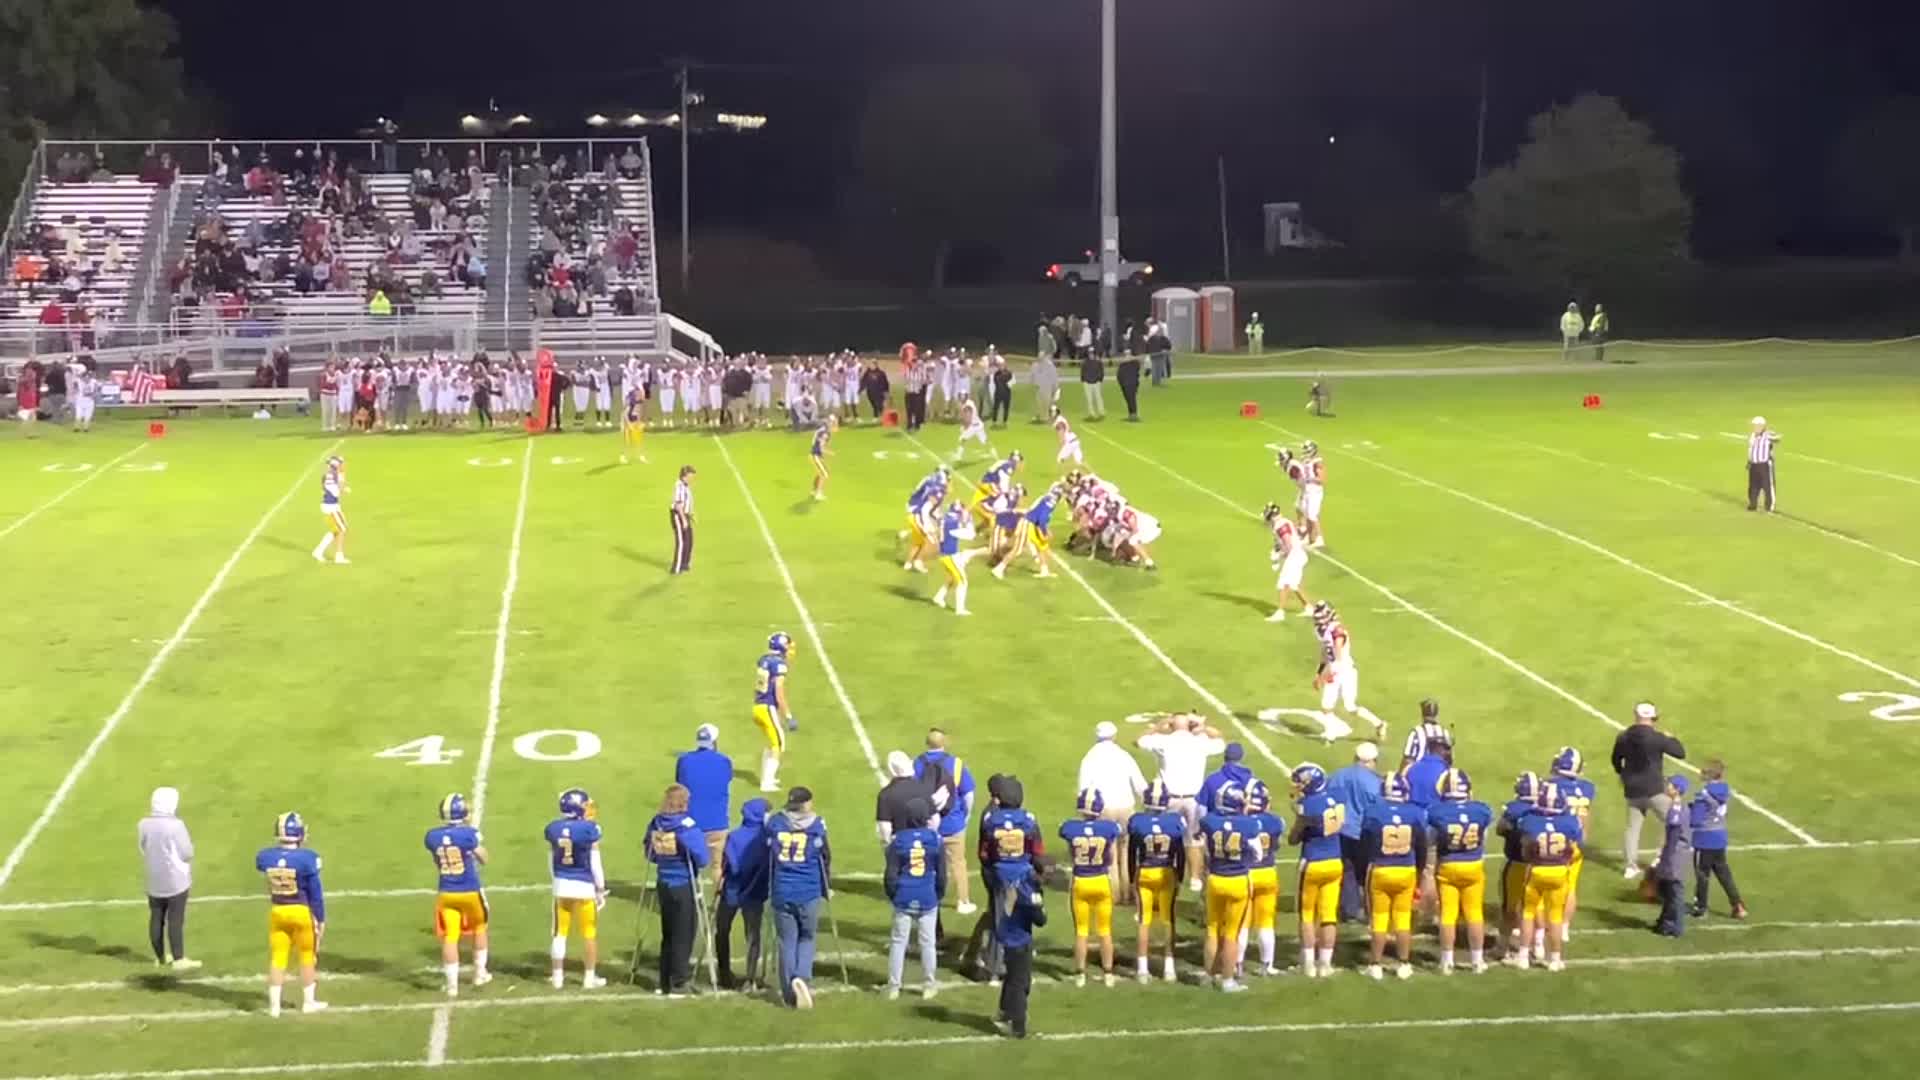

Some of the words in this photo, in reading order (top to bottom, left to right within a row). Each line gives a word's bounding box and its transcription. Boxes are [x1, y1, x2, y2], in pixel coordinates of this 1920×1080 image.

[777, 831, 808, 862] 77
[1072, 836, 1107, 865] 27
[1212, 831, 1242, 860] 14
[1537, 832, 1567, 858] 12
